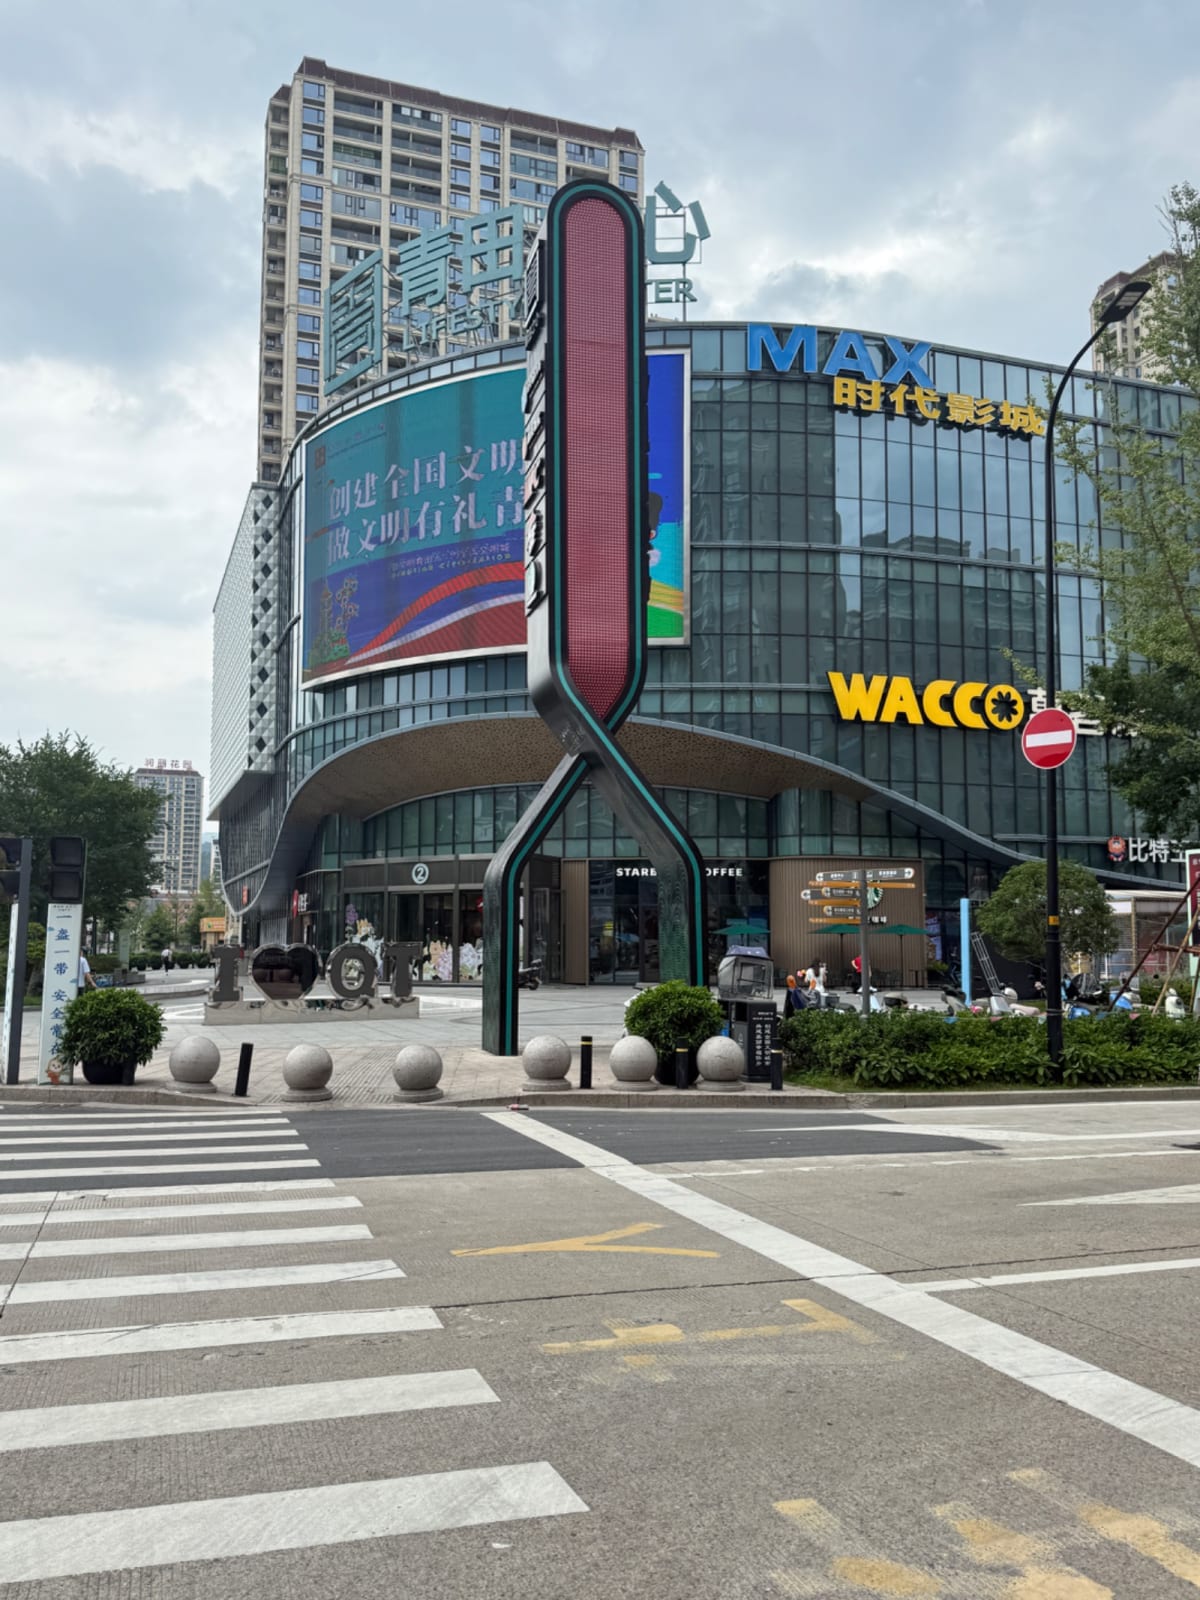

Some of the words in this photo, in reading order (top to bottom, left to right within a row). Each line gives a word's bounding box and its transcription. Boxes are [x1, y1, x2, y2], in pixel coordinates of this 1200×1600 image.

[747, 323, 936, 389] MAX
[833, 376, 1046, 437] 时代影城
[827, 672, 1025, 730] WACCO
[53, 915, 73, 976] 一盔一带
